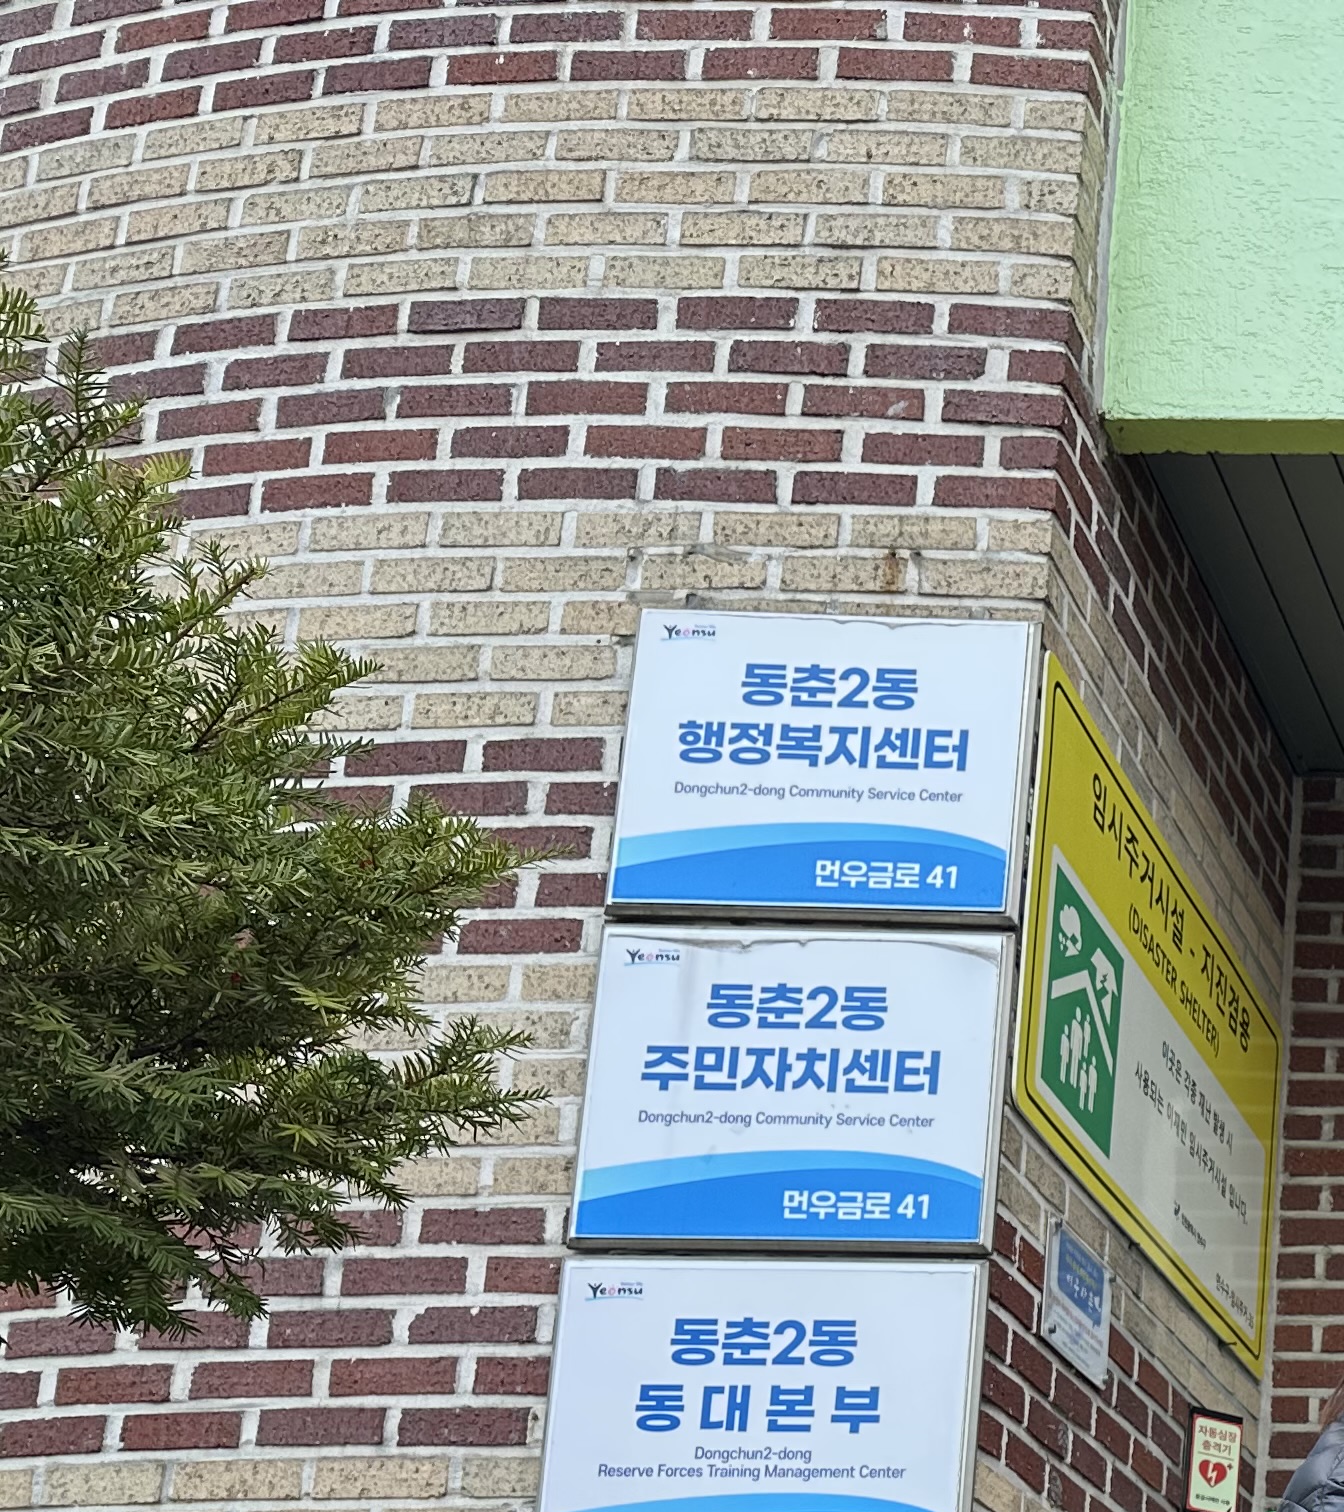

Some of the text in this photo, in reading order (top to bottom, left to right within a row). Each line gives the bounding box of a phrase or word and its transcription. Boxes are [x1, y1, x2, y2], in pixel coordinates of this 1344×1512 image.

[741, 663, 919, 711] 동춘2동
[677, 720, 969, 772] 행정복지센터
[673, 781, 963, 803] Dongchun2-dong Community Service Center
[815, 859, 957, 890] 먼우금로 41
[1093, 773, 1185, 955] 임시주거시설
[1201, 944, 1250, 1053] 지진겸용
[1129, 903, 1220, 1058] (DISASTER SHELTER)
[706, 983, 888, 1031] 동춘2동
[640, 1045, 941, 1095] 주민자치센터
[637, 1110, 935, 1129] Dongchun2-dong Community Service Center
[783, 1190, 930, 1220] 먼우금로 41
[670, 1317, 858, 1367] 동춘2동
[597, 1463, 906, 1483] Reserve Forces Training Management Center
[694, 1446, 812, 1464] Dongchun2-dong
